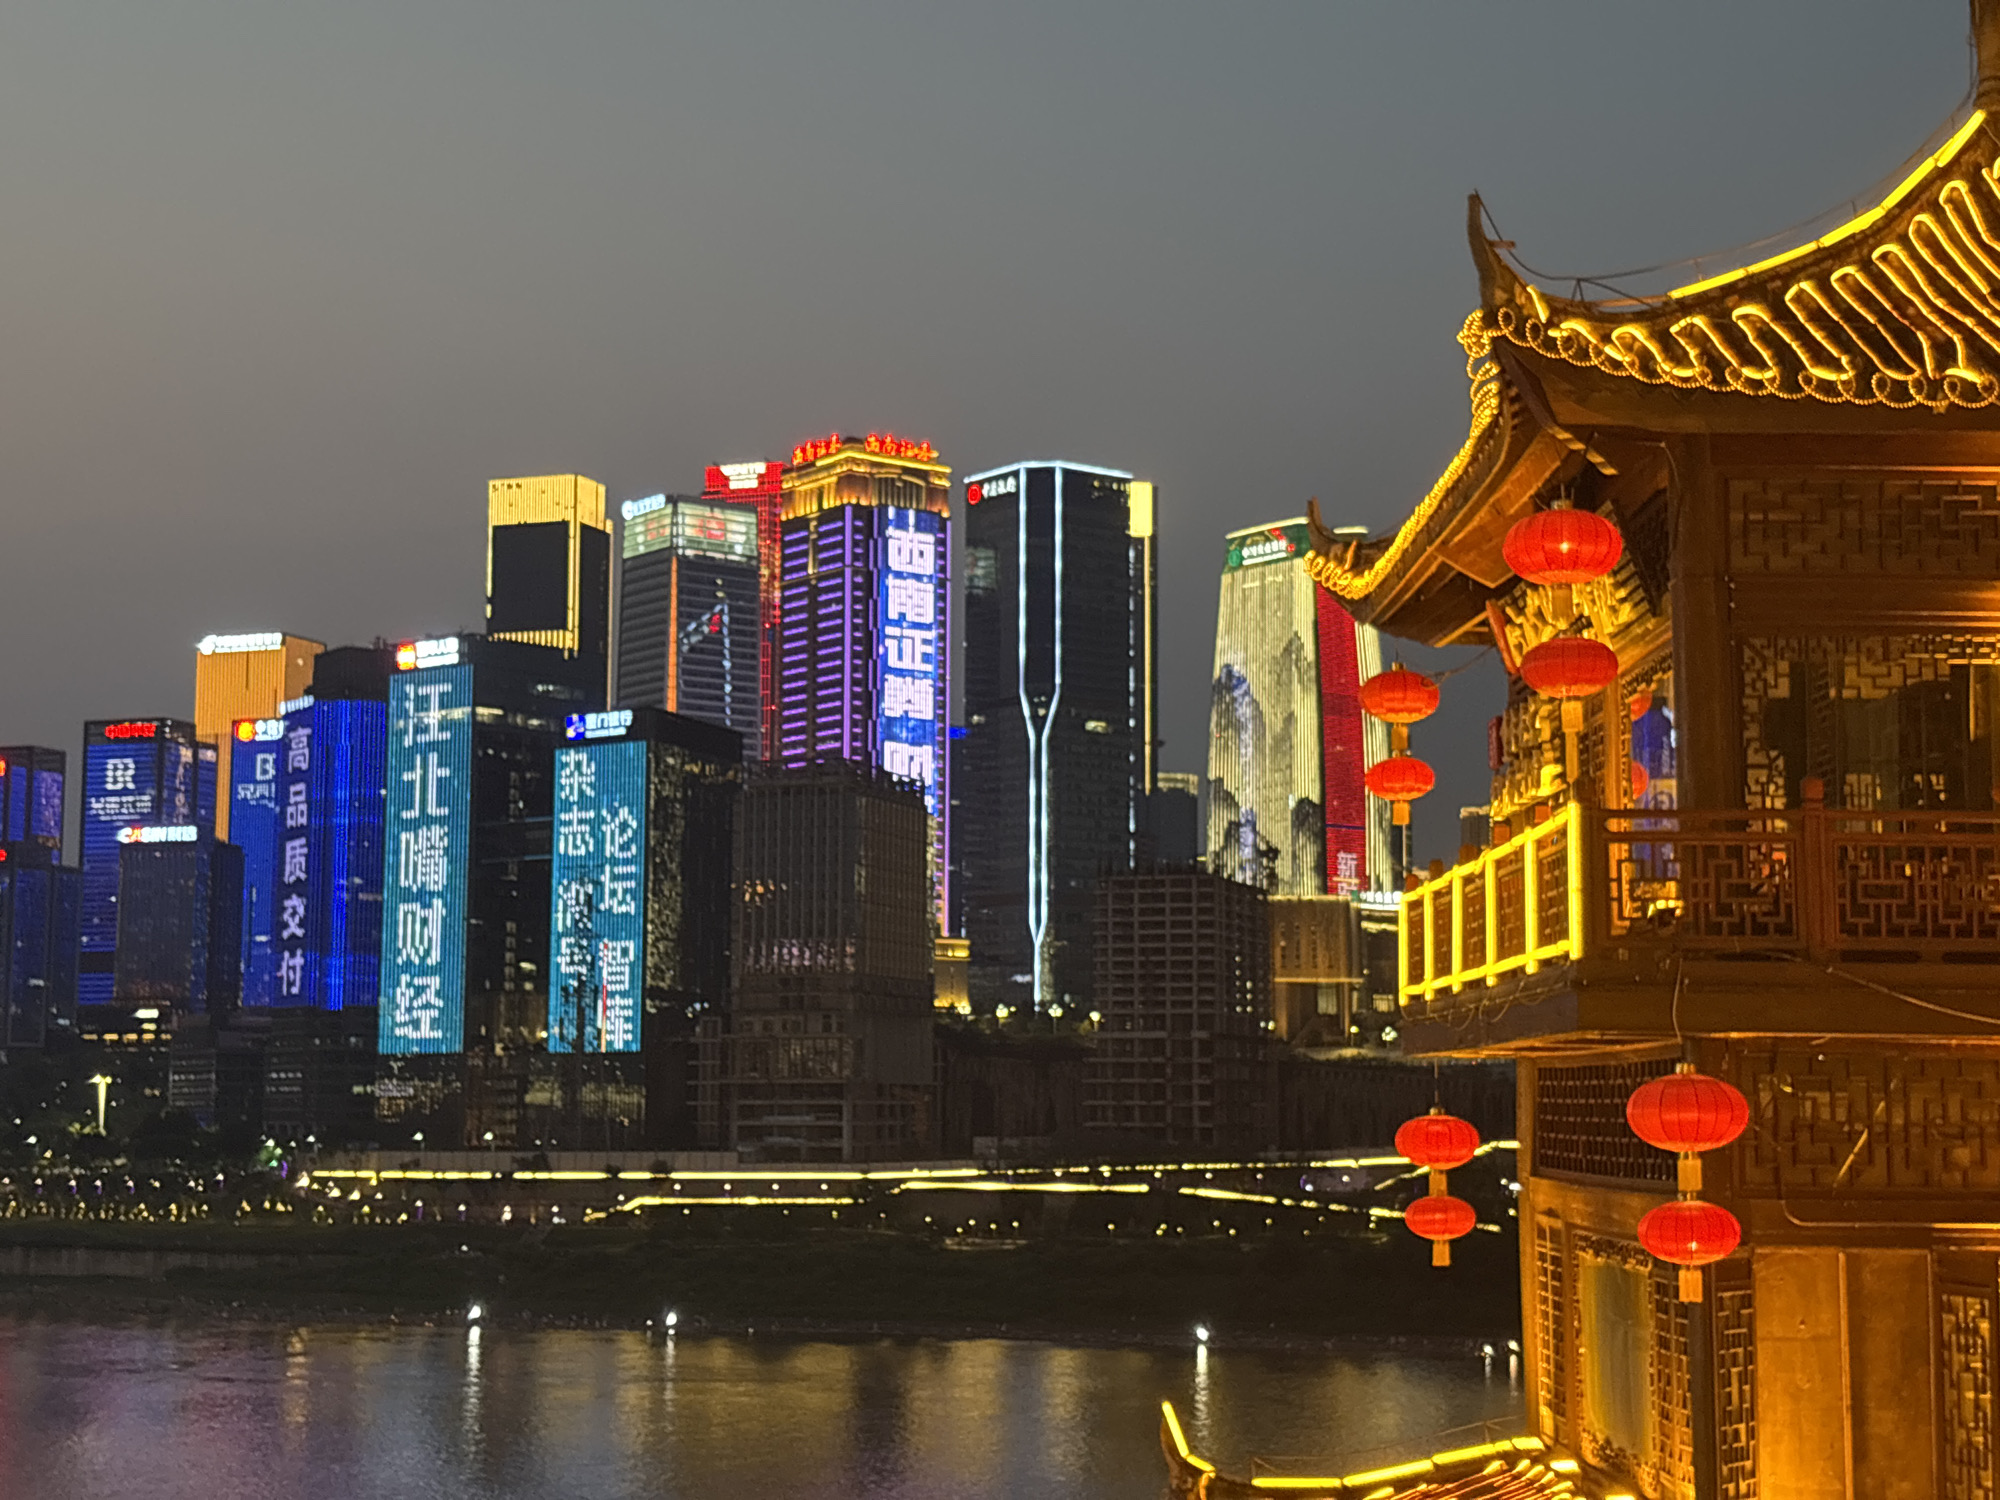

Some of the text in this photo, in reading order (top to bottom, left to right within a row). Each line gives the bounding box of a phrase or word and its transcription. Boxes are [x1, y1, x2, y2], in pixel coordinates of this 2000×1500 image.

[280, 725, 313, 996] 高品质交付
[394, 682, 452, 1040] 江北嘴财经
